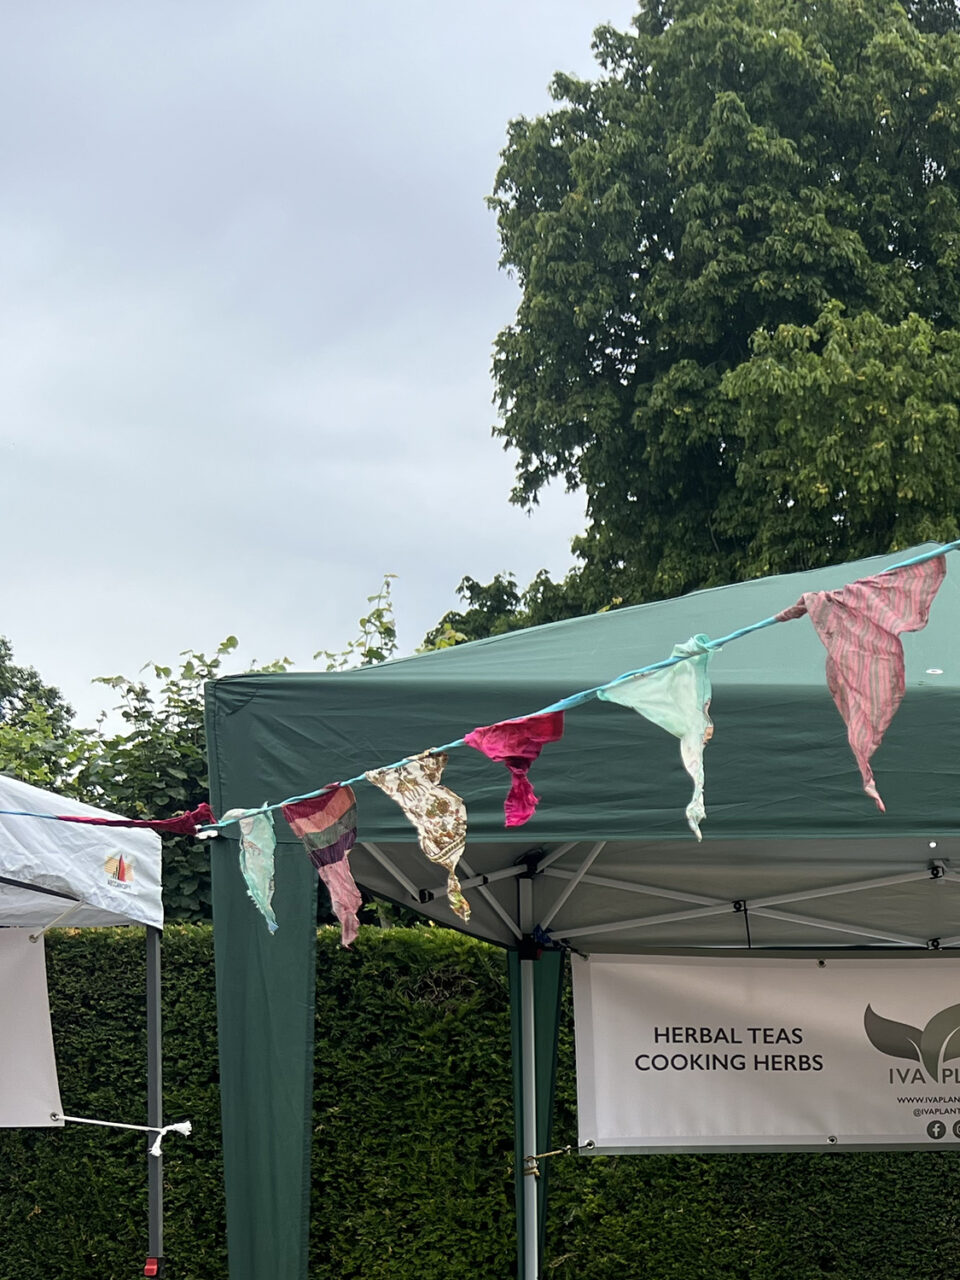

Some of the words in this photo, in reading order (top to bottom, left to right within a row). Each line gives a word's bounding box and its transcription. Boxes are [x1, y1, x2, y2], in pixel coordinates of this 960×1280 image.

[654, 1026, 743, 1044] HERBAL
[746, 1027, 803, 1045] TEAS
[634, 1053, 746, 1071] COOKING
[753, 1054, 824, 1072] HERBS
[889, 1068, 926, 1084] IVA
